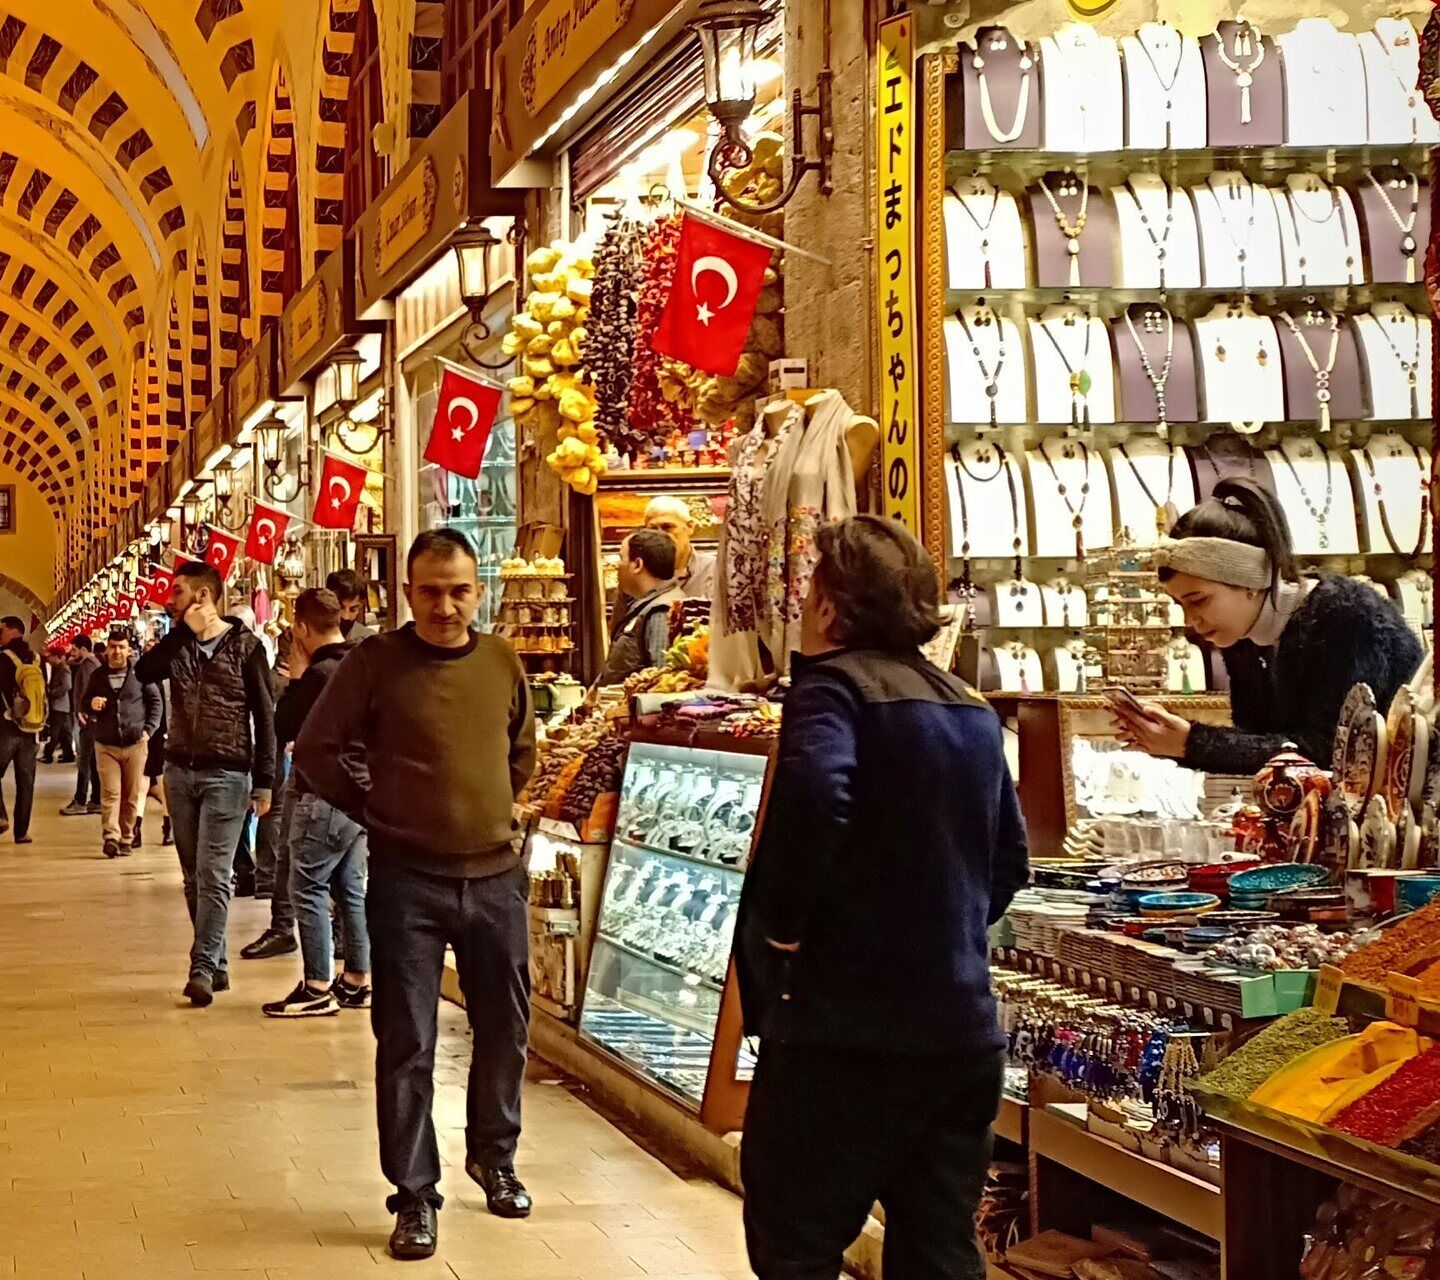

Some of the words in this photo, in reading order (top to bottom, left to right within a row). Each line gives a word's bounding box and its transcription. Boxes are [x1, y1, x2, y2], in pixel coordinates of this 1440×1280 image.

[883, 76, 908, 524] エドまっちゃんの
